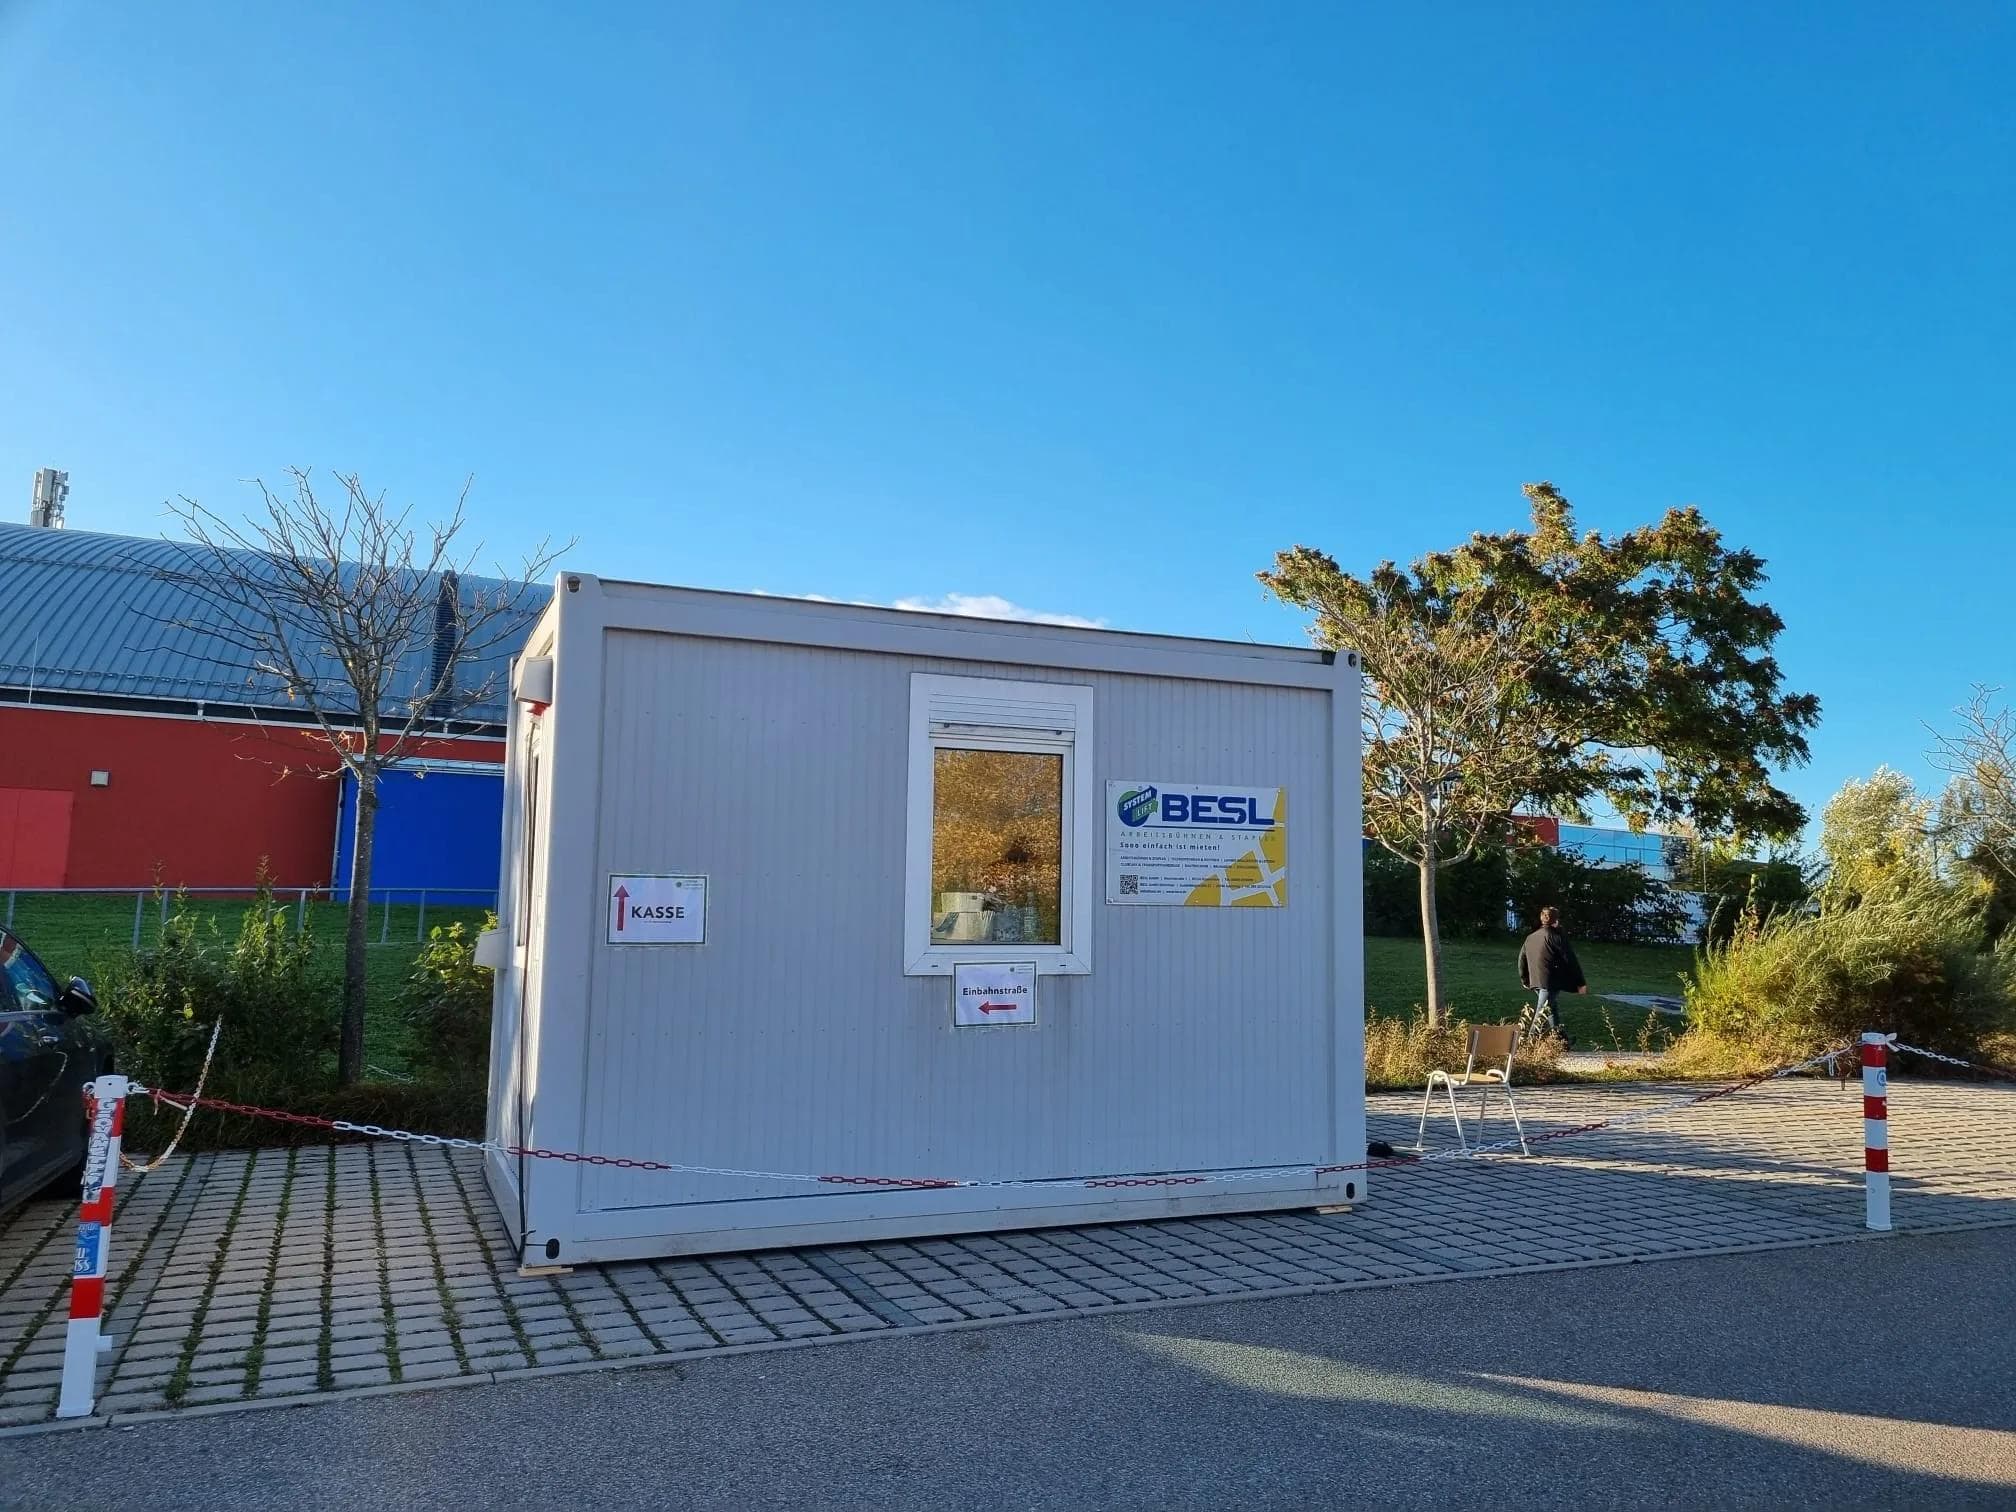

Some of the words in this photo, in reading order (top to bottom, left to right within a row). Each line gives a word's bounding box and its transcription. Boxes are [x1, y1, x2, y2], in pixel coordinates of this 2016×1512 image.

[1123, 789, 1152, 811] SYSTEM
[1136, 802, 1153, 817] LIFT
[1162, 793, 1275, 825] BESL
[1176, 842, 1186, 850] ist
[1189, 843, 1220, 851] mieten!
[631, 906, 685, 919] KASSE
[962, 985, 1028, 996] Einbahnstraße
